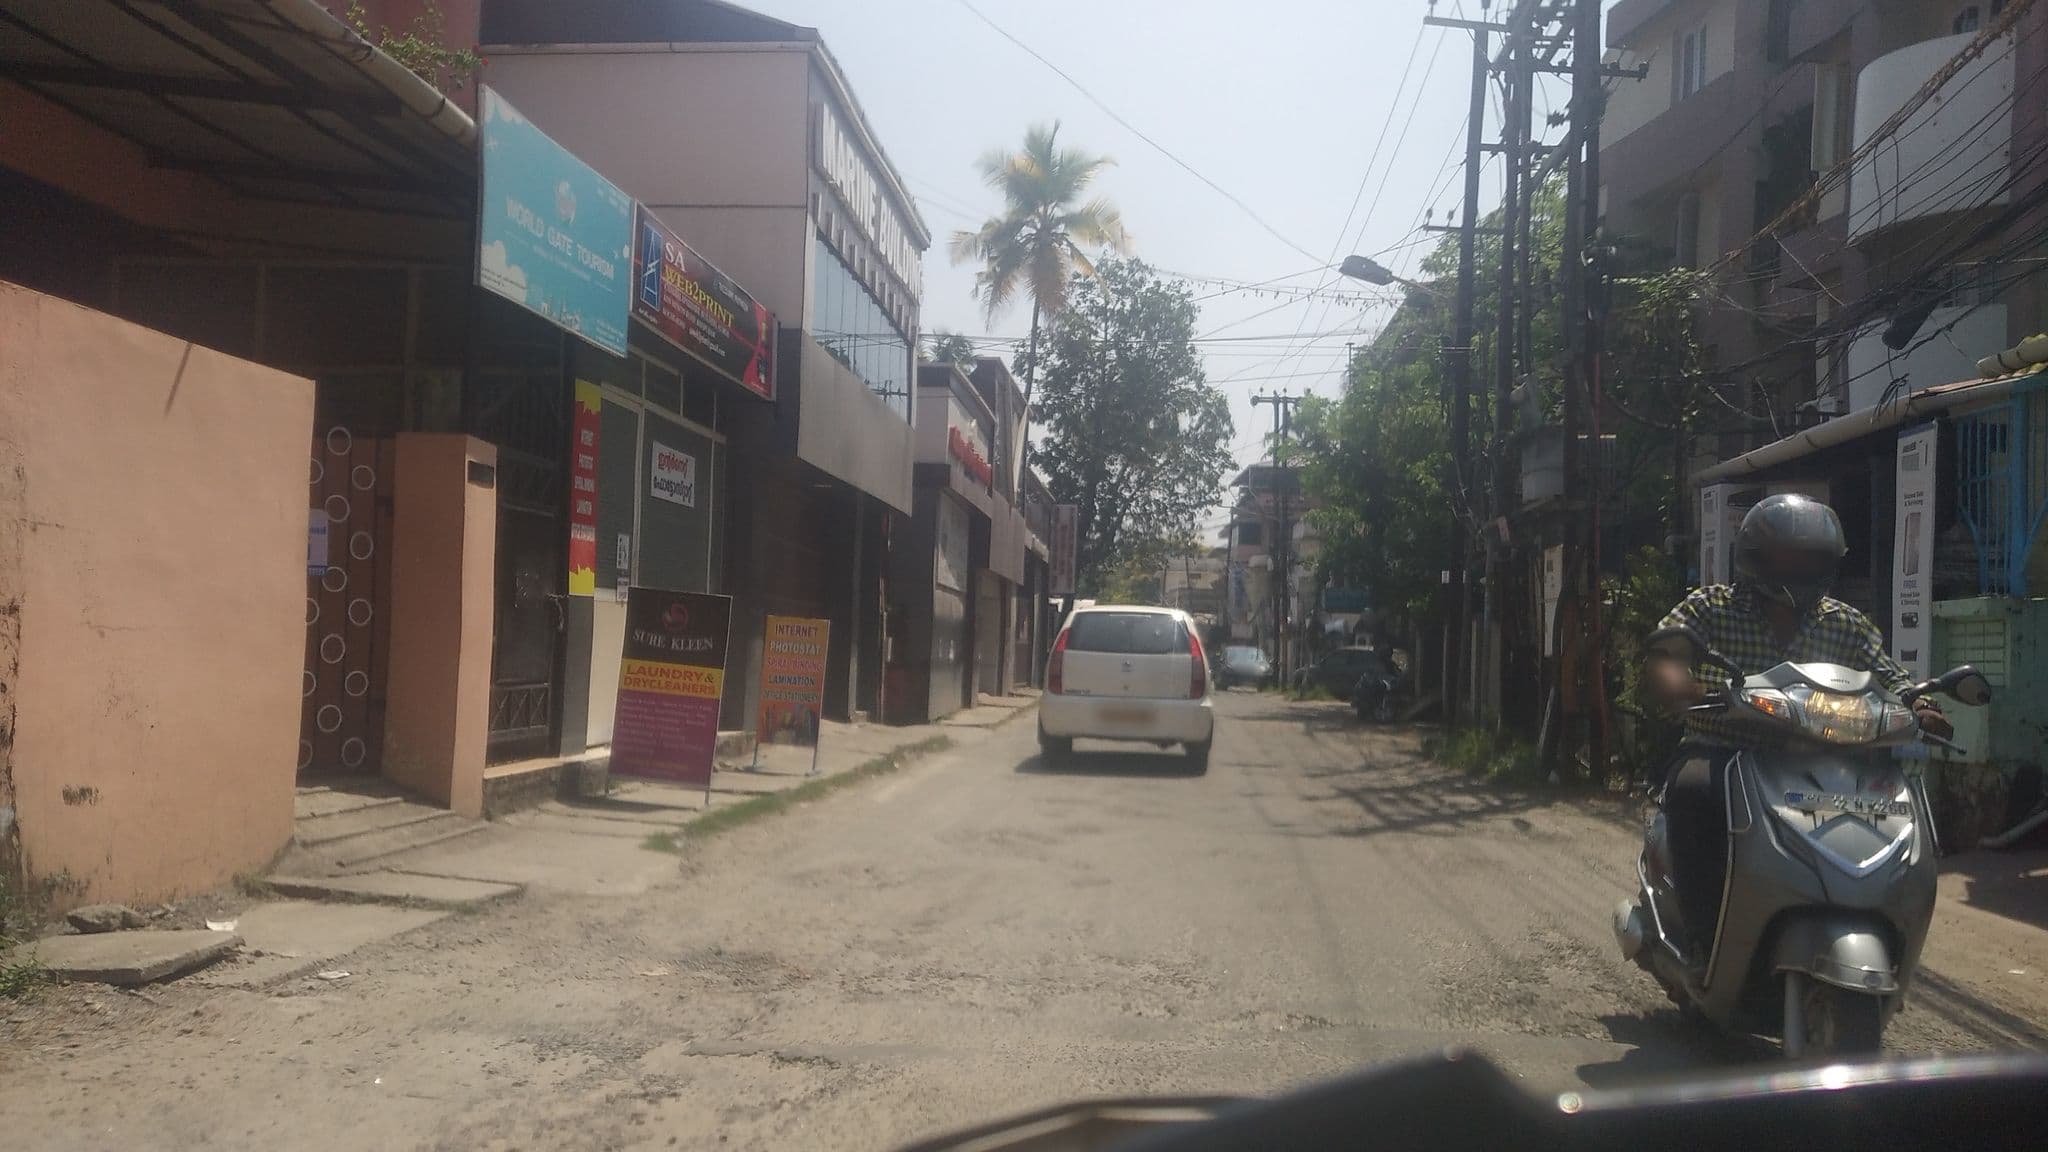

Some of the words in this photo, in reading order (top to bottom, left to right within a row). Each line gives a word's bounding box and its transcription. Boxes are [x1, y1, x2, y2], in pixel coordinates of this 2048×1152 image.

[822, 100, 877, 242] MARINE
[506, 197, 545, 239] WORLD
[547, 227, 574, 256] GATE
[575, 242, 616, 281] TOURISM
[664, 242, 687, 274] SA
[663, 264, 736, 330] WEB2PRINT
[632, 628, 666, 649] SURE
[671, 636, 714, 651] KLEEN
[775, 623, 818, 638] INTERNET
[769, 640, 821, 655] PHOTOSTAT
[626, 664, 704, 682] LAUNDRY
[705, 673, 715, 683] &
[767, 673, 816, 687] LAMINATION
[623, 676, 716, 695] DRYCLEANERS
